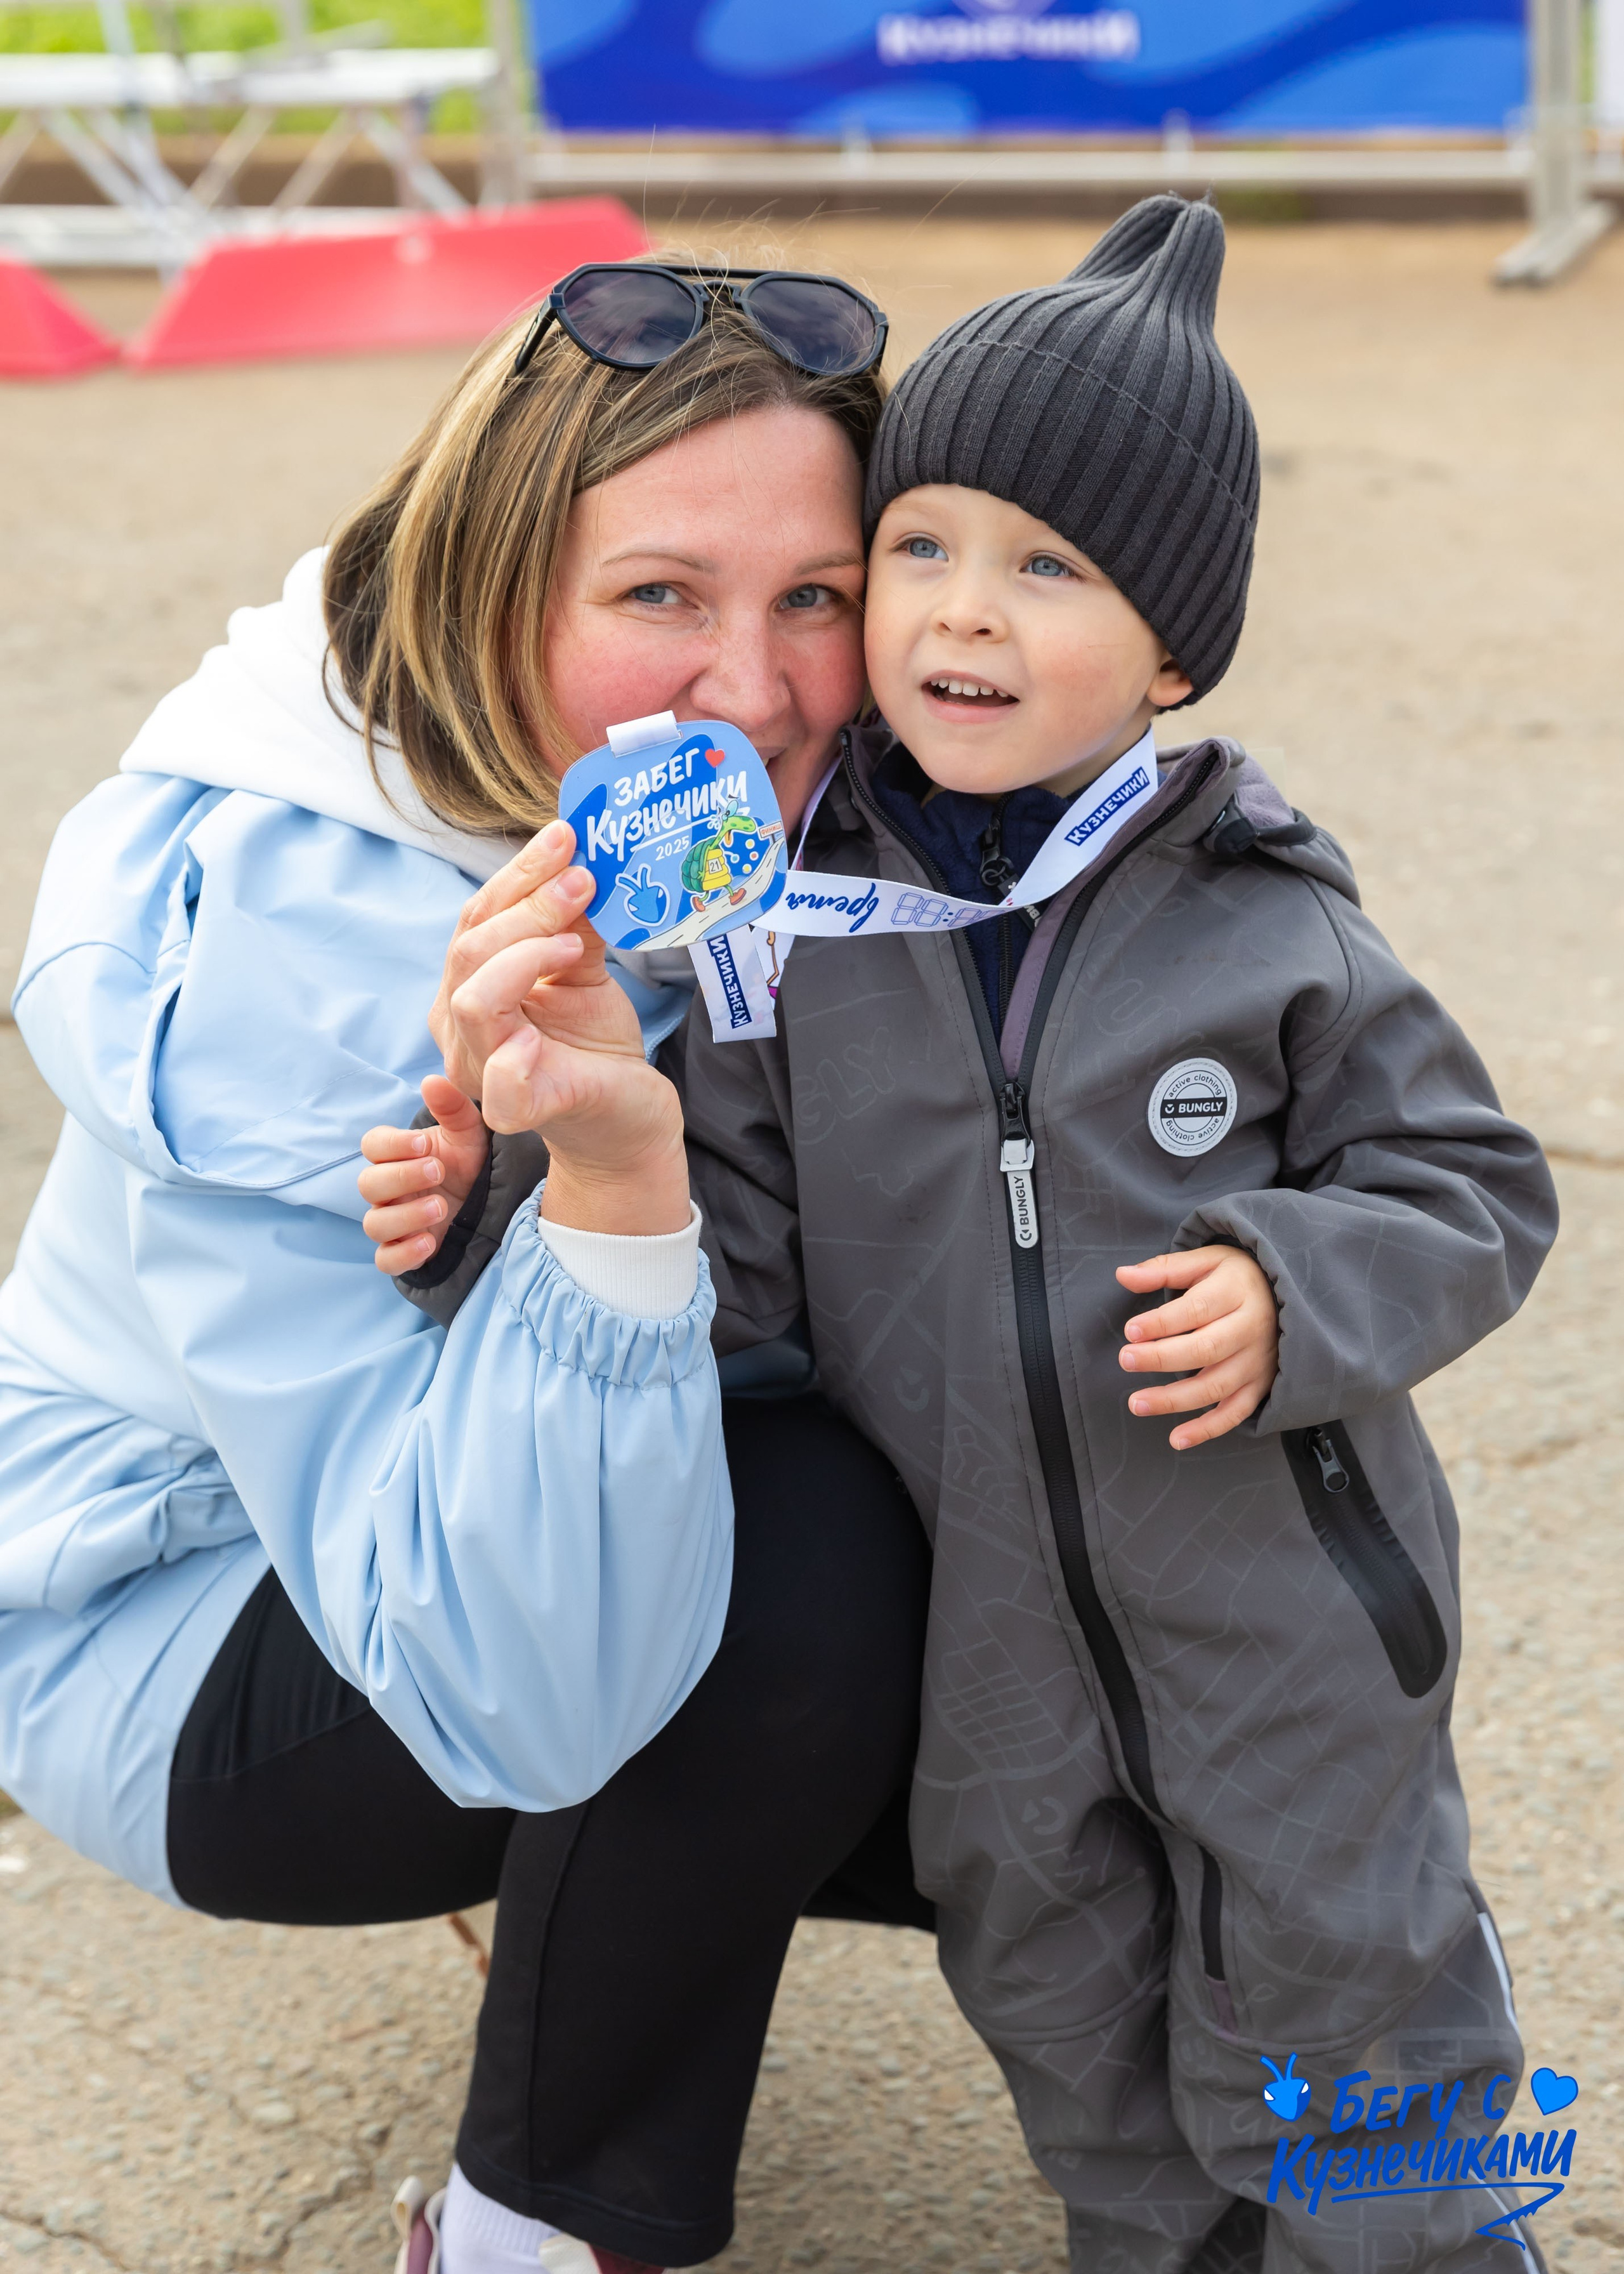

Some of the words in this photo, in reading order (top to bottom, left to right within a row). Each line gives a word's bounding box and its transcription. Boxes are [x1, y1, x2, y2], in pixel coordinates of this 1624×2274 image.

[613, 747, 700, 807] ЗАБЕГ
[1067, 769, 1149, 844] КУЗНЕЧИКИ
[655, 835, 690, 862] 2025
[710, 859, 719, 872] 21
[710, 935, 749, 1027] КУЗНЕЧИКИ
[1169, 1076, 1191, 1098] active
[1194, 1074, 1222, 1096] clothing
[1178, 1101, 1224, 1114] BUNGLY
[1166, 1120, 1195, 1141] clothing
[1198, 1118, 1219, 1138] active
[1013, 1176, 1030, 1225] BUNGLY
